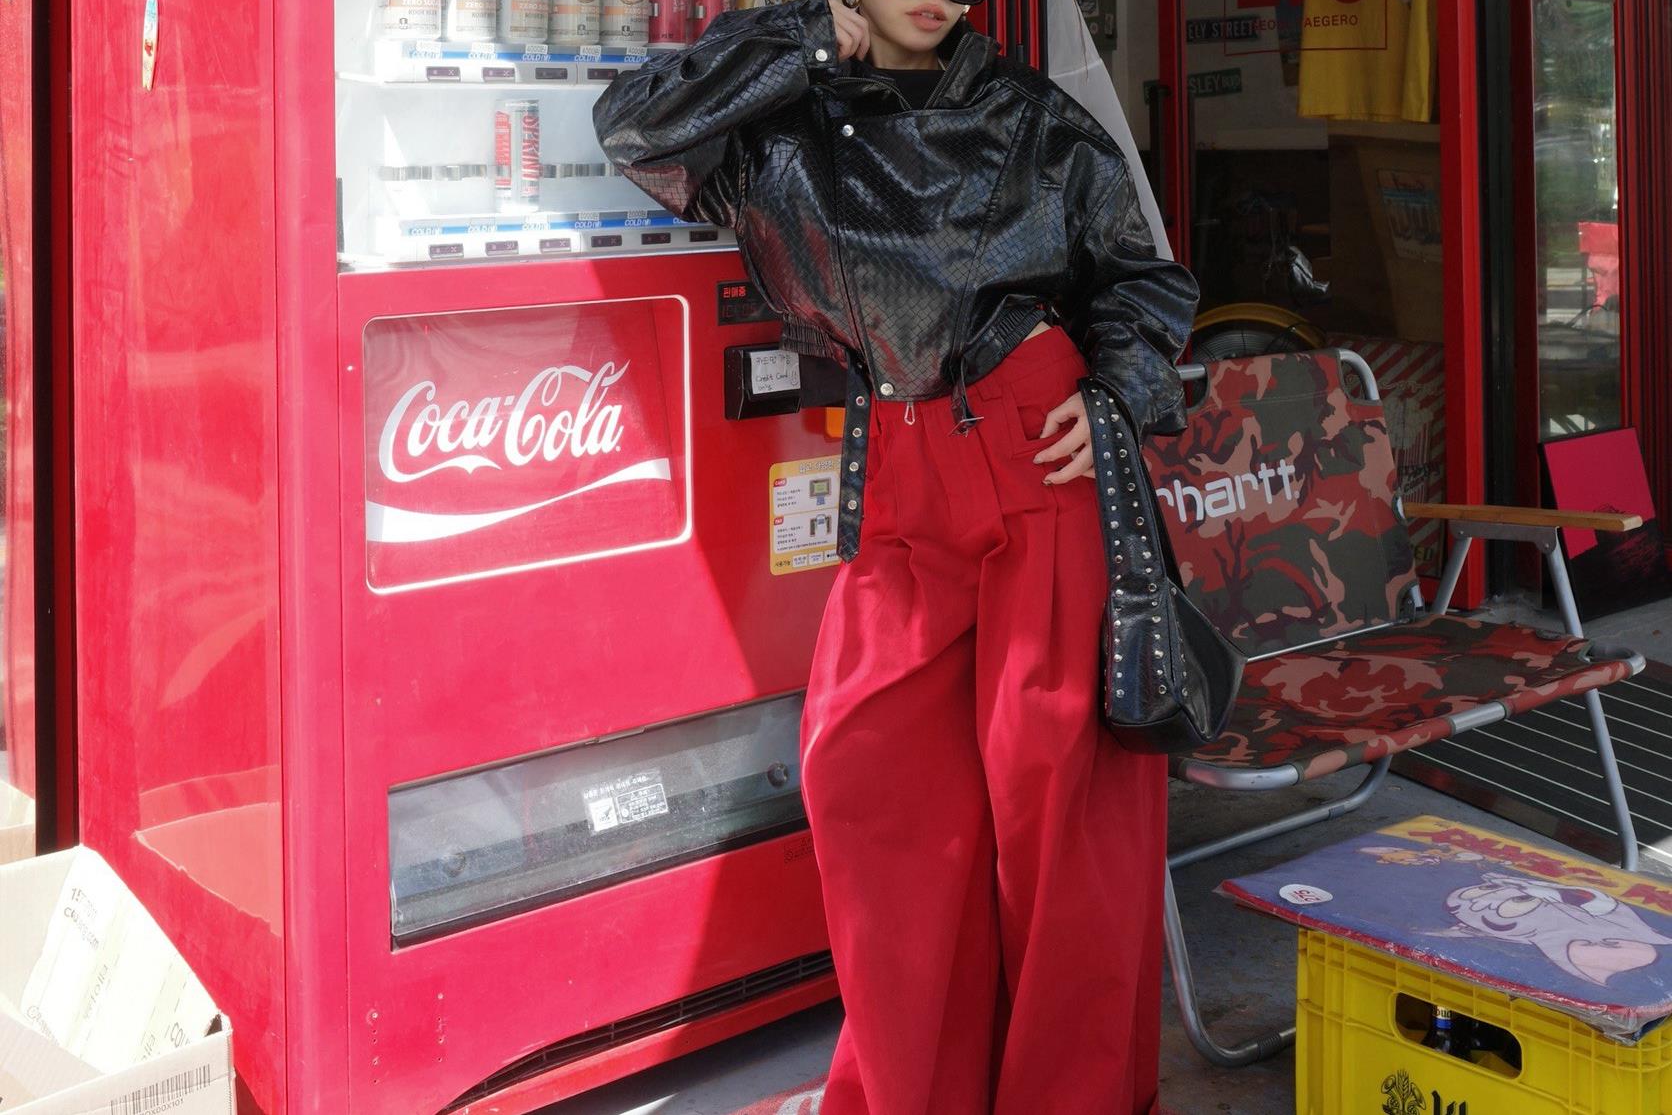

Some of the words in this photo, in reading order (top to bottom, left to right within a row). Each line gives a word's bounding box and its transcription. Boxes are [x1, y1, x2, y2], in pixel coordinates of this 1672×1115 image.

[1212, 20, 1253, 38] STREET
[1301, 14, 1358, 28] AEGERO
[378, 359, 631, 483] Coca-Cola
